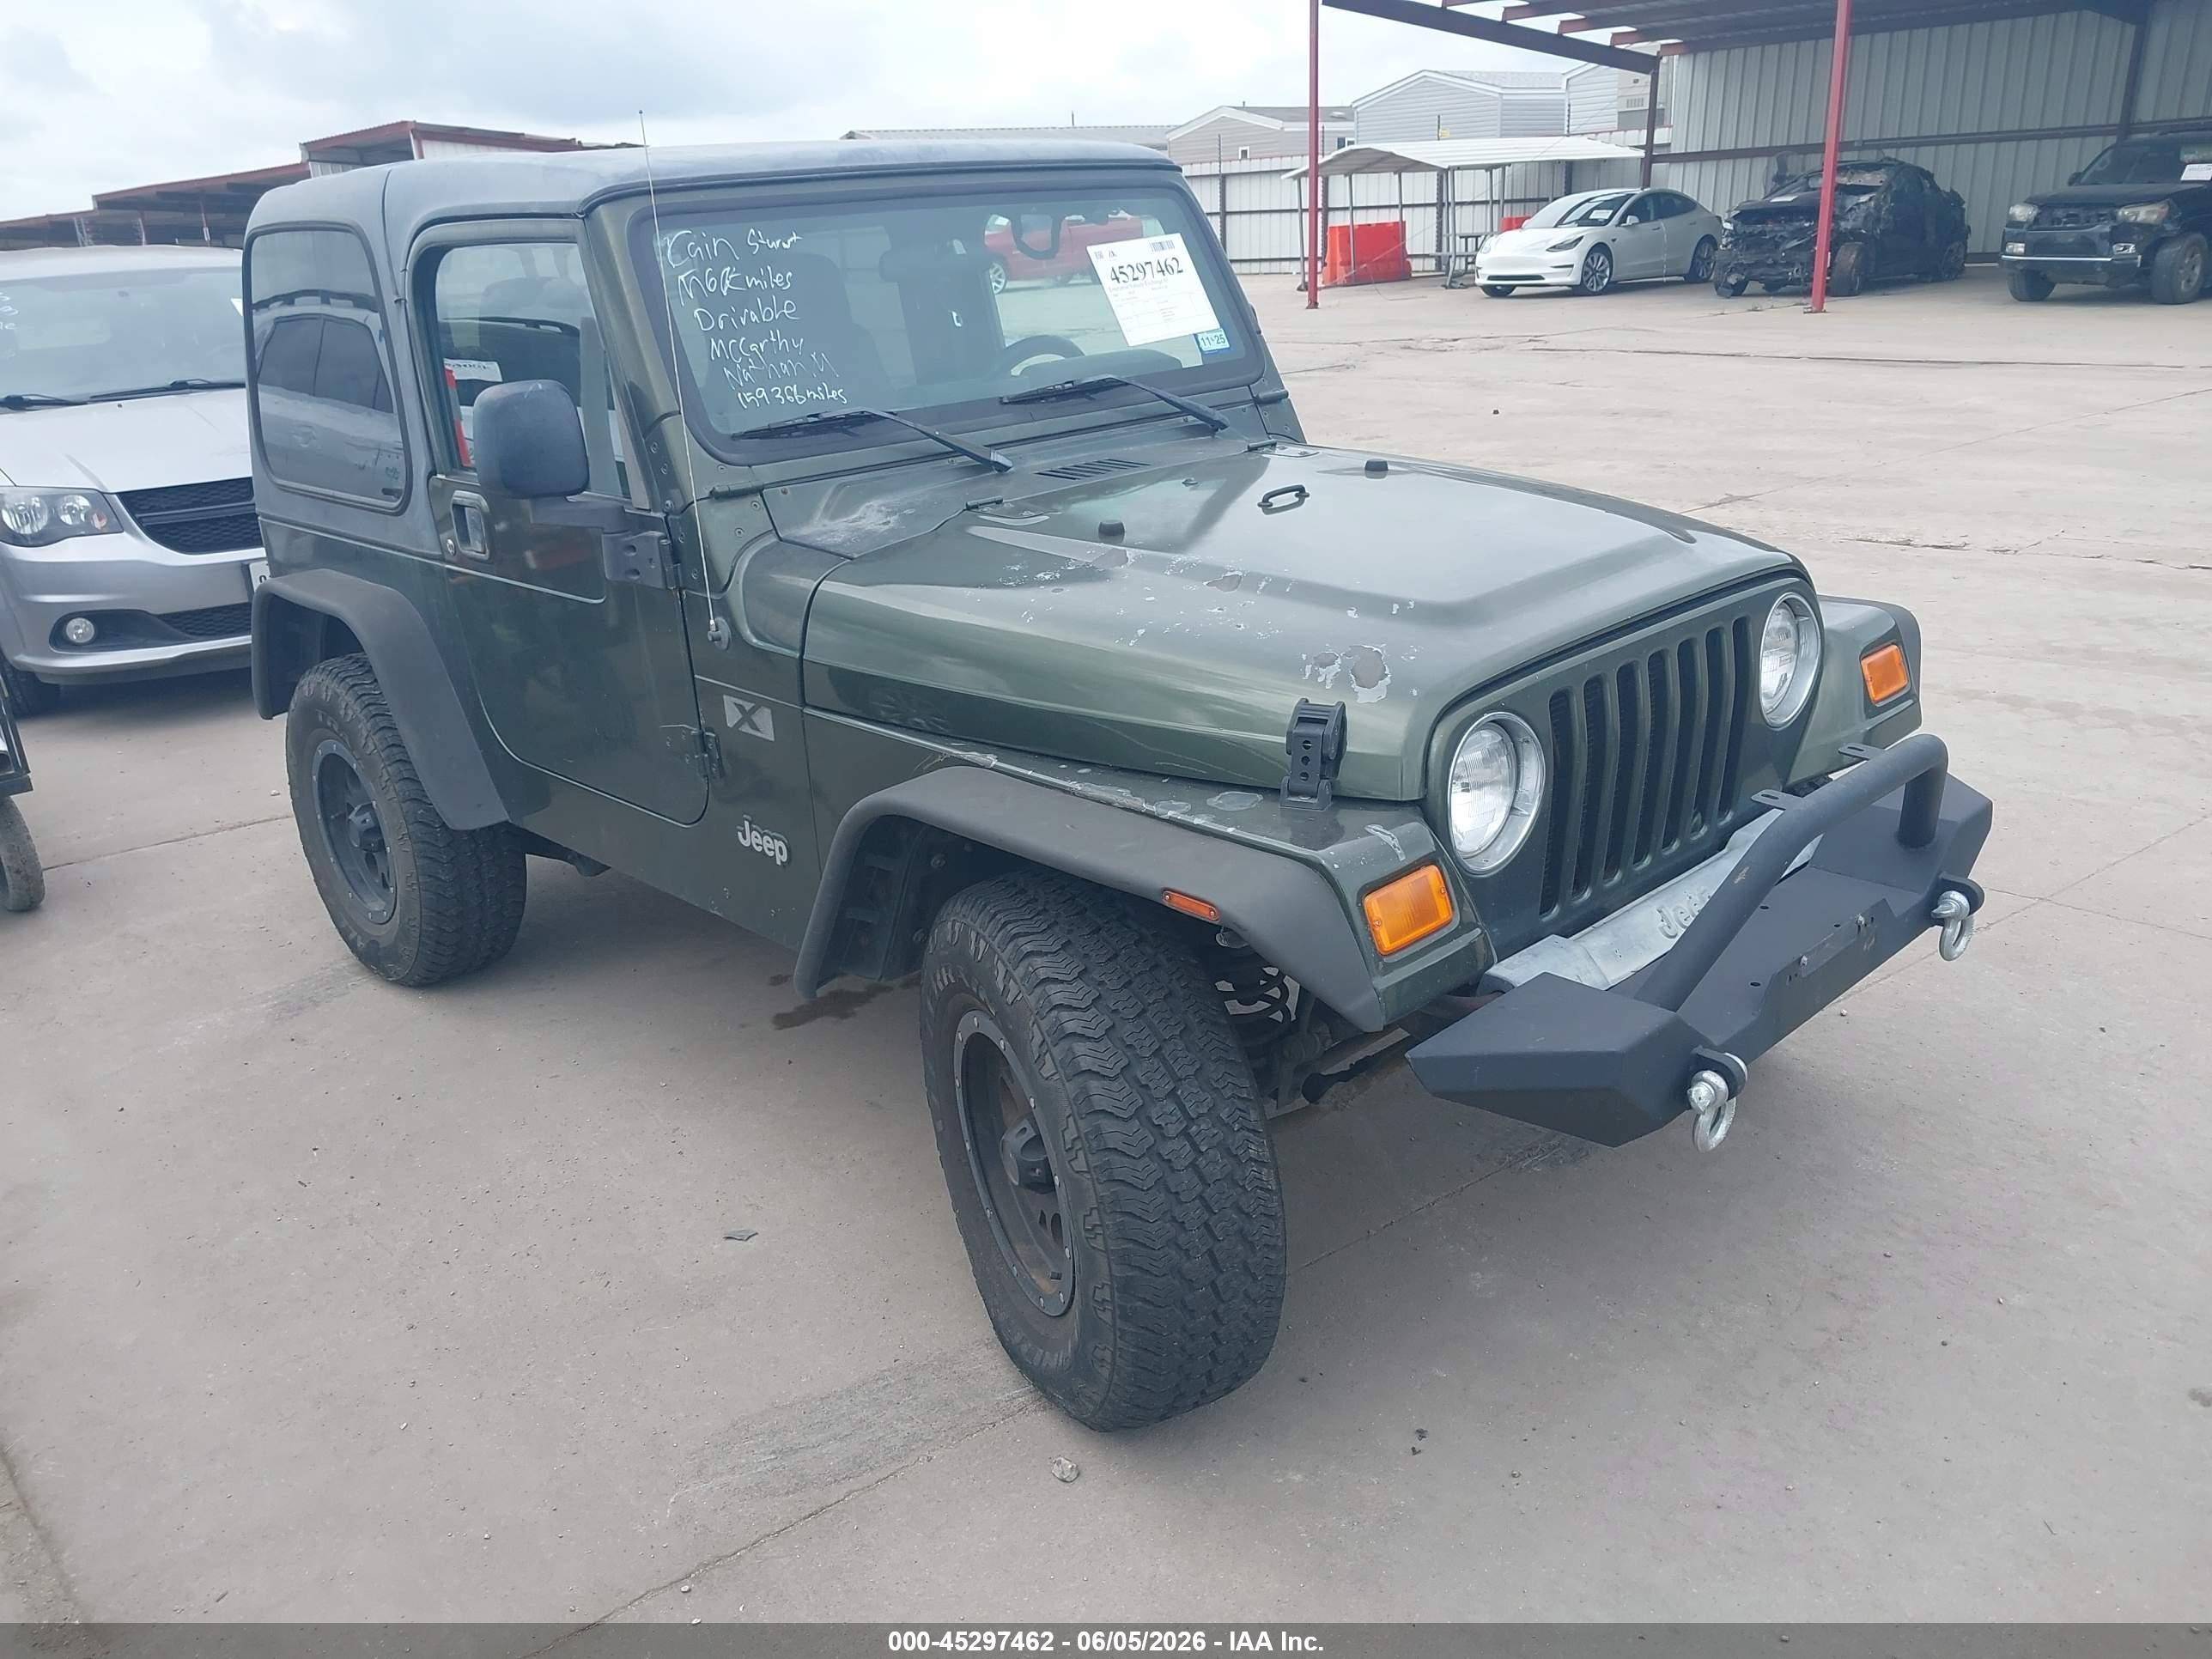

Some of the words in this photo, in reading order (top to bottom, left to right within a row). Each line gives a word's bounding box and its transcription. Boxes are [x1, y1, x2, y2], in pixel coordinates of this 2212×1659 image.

[745, 265, 793, 290] miles
[1110, 257, 1183, 283] 45297462
[694, 295, 802, 331] Drivable
[1213, 333, 1226, 344] 25
[738, 819, 787, 866] Jeep
